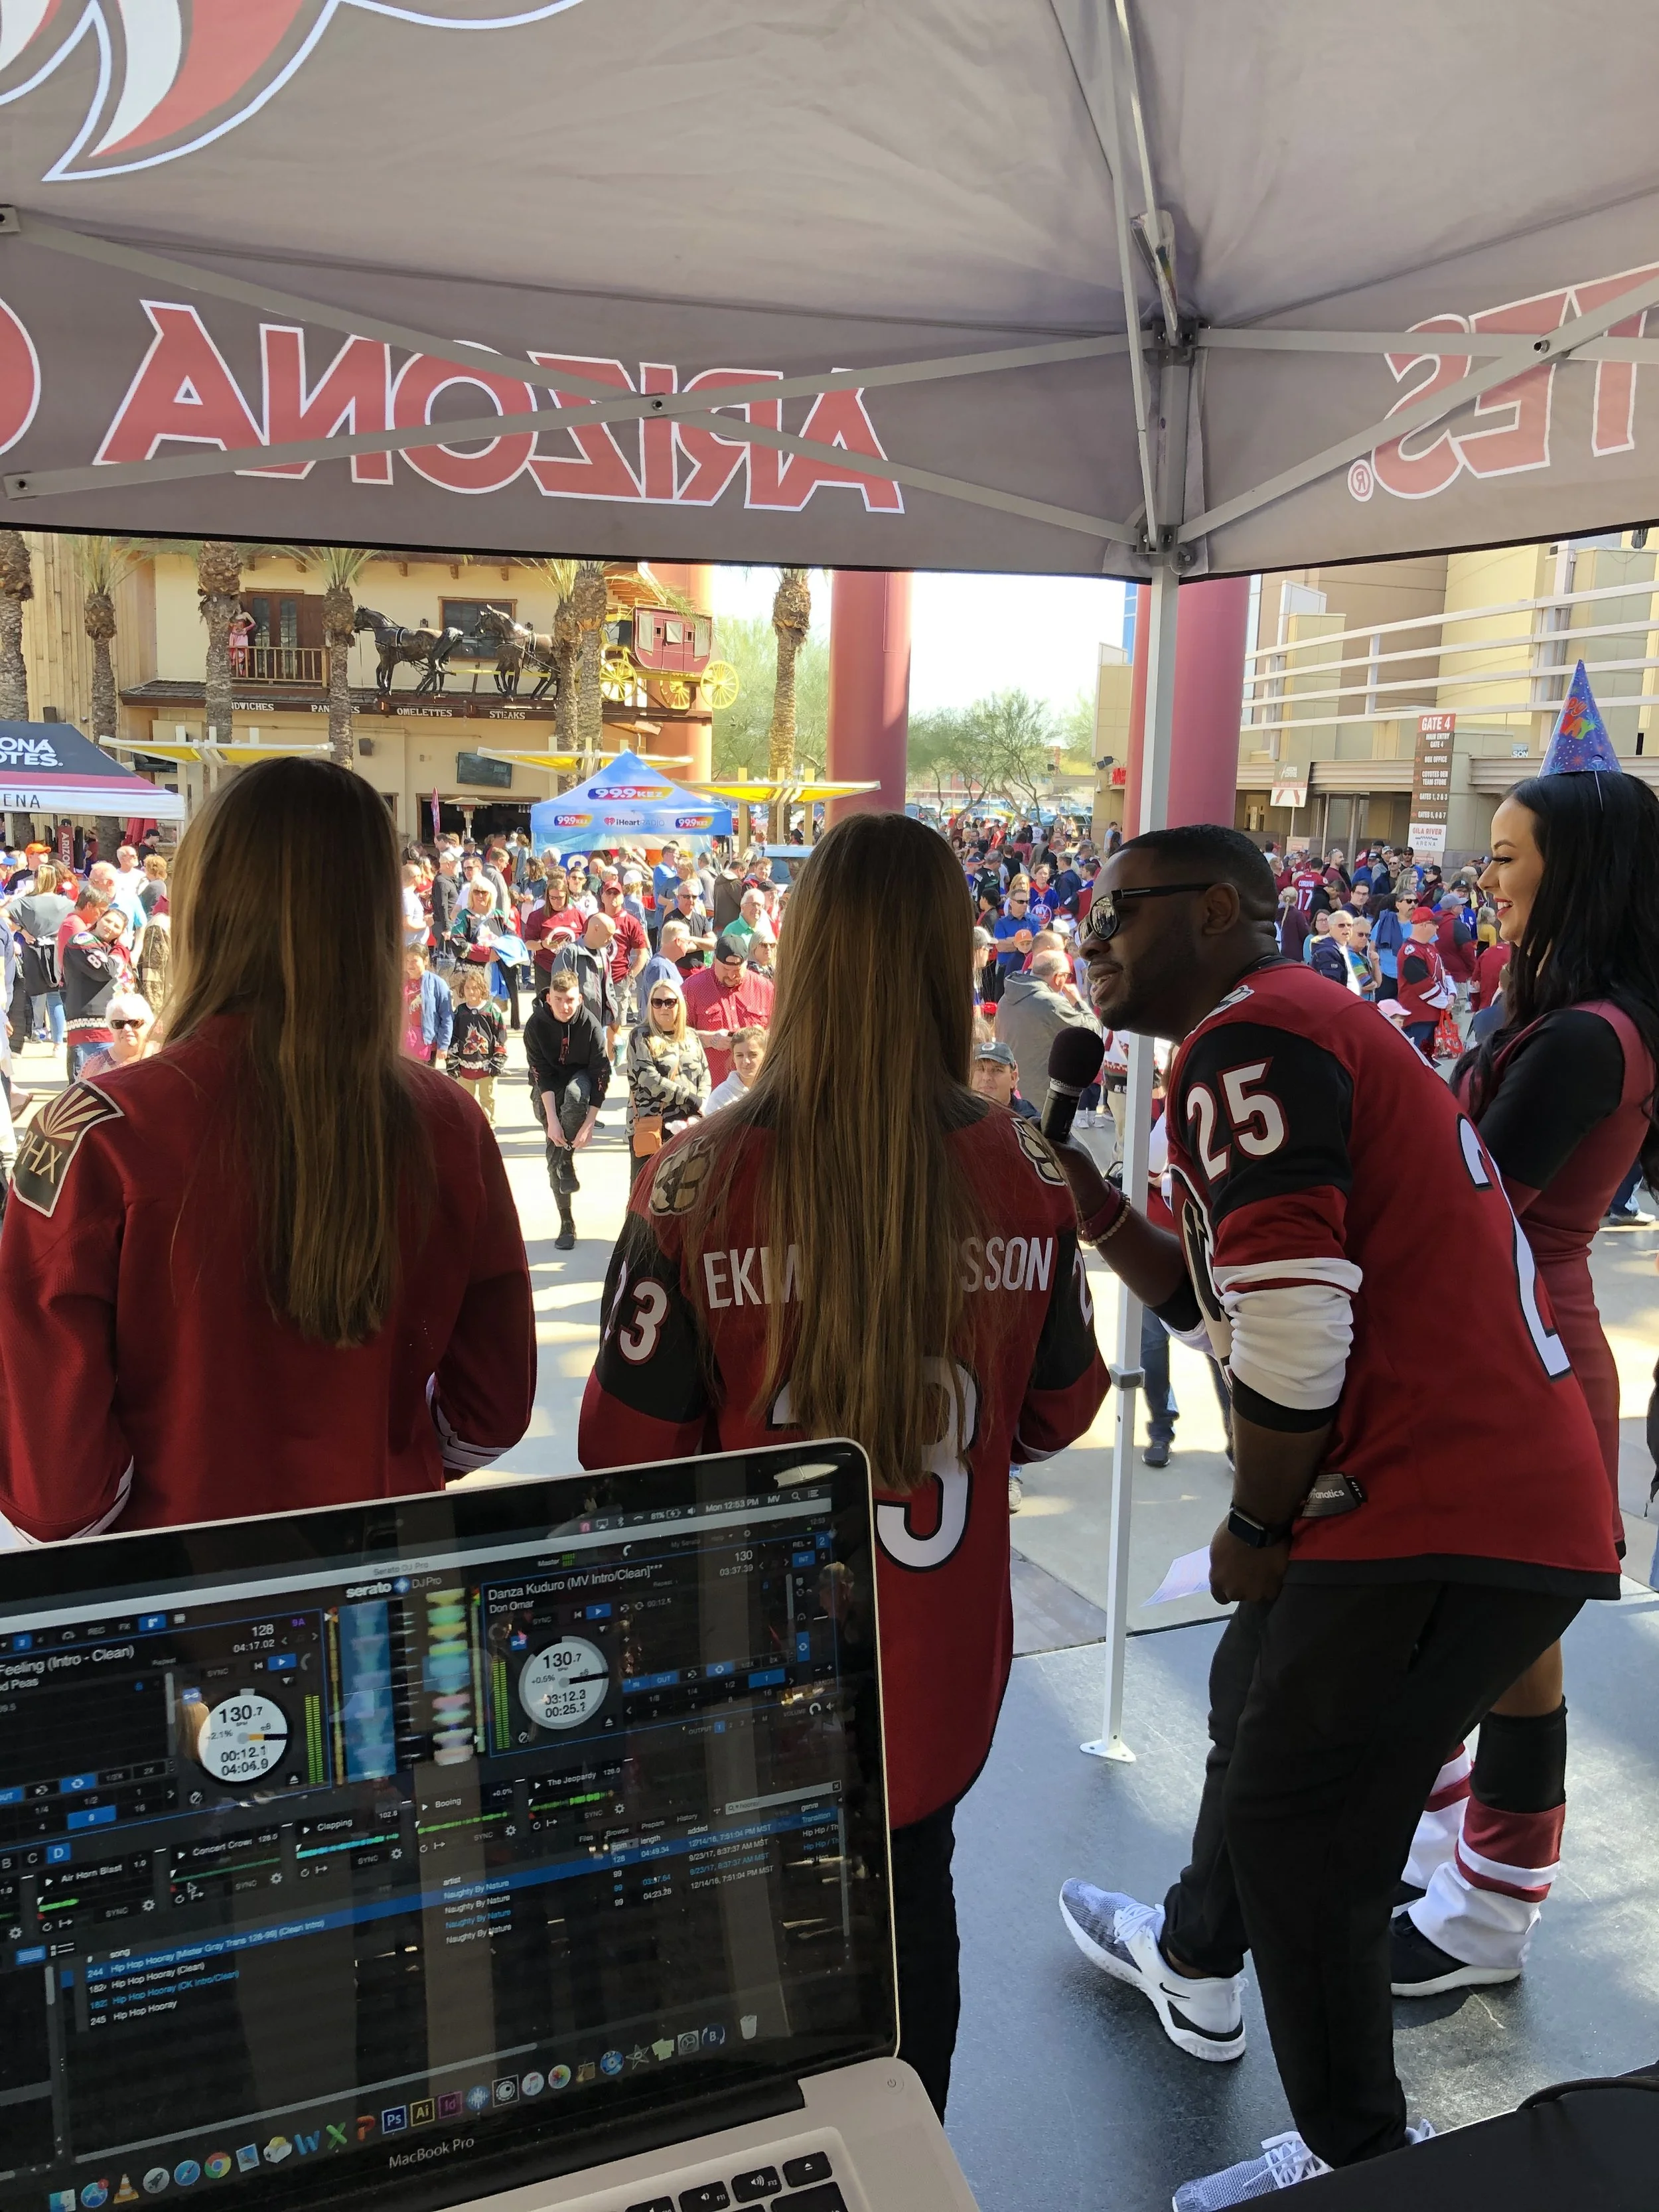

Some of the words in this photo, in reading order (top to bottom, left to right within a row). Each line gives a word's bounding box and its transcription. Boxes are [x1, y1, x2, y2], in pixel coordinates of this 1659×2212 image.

[397, 707, 453, 717] OMELETTES
[489, 710, 526, 719] STEAKS
[1421, 717, 1442, 731] GATE
[1444, 716, 1451, 730] 4
[1297, 889, 1313, 911] 17
[1186, 1061, 1289, 1180] 25
[19, 1130, 62, 1185] PHX
[705, 1504, 722, 1513] Mon
[723, 1501, 745, 1510] 12:53
[747, 1498, 758, 1507] PM
[767, 1495, 780, 1504] MV
[819, 1537, 826, 1546] 2
[735, 1550, 753, 1562] 130
[346, 1582, 392, 1598] serato
[488, 1586, 524, 1601] Danza
[526, 1581, 565, 1594] Kuduro
[567, 1576, 590, 1590] (MV
[489, 1605, 508, 1614] Don
[508, 1599, 535, 1611] Omar
[291, 1618, 305, 1627] 9A
[251, 1624, 275, 1637] 128
[233, 1639, 275, 1653] 04:17.02
[11, 1678, 40, 1690] Peas
[547, 1778, 562, 1787] The
[563, 1771, 597, 1785] Jeopardy
[435, 1797, 462, 1809] Booing
[583, 1809, 603, 1819] SYNC
[317, 1818, 353, 1832] Clapping
[606, 1827, 630, 1838] Browse
[676, 1813, 698, 1823] History
[474, 1831, 494, 1841] SYNC
[640, 1834, 662, 1846] length
[1, 1858, 12, 1870] B
[27, 1852, 38, 1864] C
[53, 1848, 64, 1859] D
[613, 1855, 626, 1864] 128
[60, 1874, 74, 1883] Air
[76, 1870, 98, 1881] Horn
[100, 1864, 123, 1876] Blast
[747, 1868, 758, 1878] PM
[758, 1865, 774, 1874] MST
[235, 1880, 257, 1891] SYNC
[443, 1876, 462, 1887] artist
[444, 1886, 474, 1900] Naughty
[474, 1885, 484, 1893] By
[486, 1880, 510, 1890] Nature
[445, 1901, 474, 1915] Naughty
[475, 1899, 486, 1908] By
[486, 1894, 510, 1905] Nature
[105, 1907, 129, 1918] SYNC
[445, 1916, 476, 1929] Naughty
[476, 1914, 486, 1923] By
[488, 1909, 511, 1919] Nature
[446, 1931, 476, 1945] Naughty
[477, 1929, 487, 1938] By
[488, 1923, 512, 1935] Nature
[109, 1949, 131, 1959] song
[88, 1968, 104, 1978] 244
[111, 1978, 126, 1989] Hip
[127, 1974, 145, 1986] Hop
[146, 1968, 177, 1981] Hooray
[111, 1994, 127, 2006] Hip
[128, 1990, 146, 2002] Hop
[147, 1983, 177, 1997] Hooray
[113, 2010, 128, 2022] Hip
[129, 2006, 147, 2018] Hop
[147, 2000, 178, 2014] Hooray
[90, 2015, 107, 2026] 245
[416, 2105, 429, 2119] Ai
[444, 2099, 456, 2111] Id
[386, 2114, 401, 2126] Ps
[388, 2142, 449, 2169] MacBook
[452, 2138, 475, 2152] Pro
